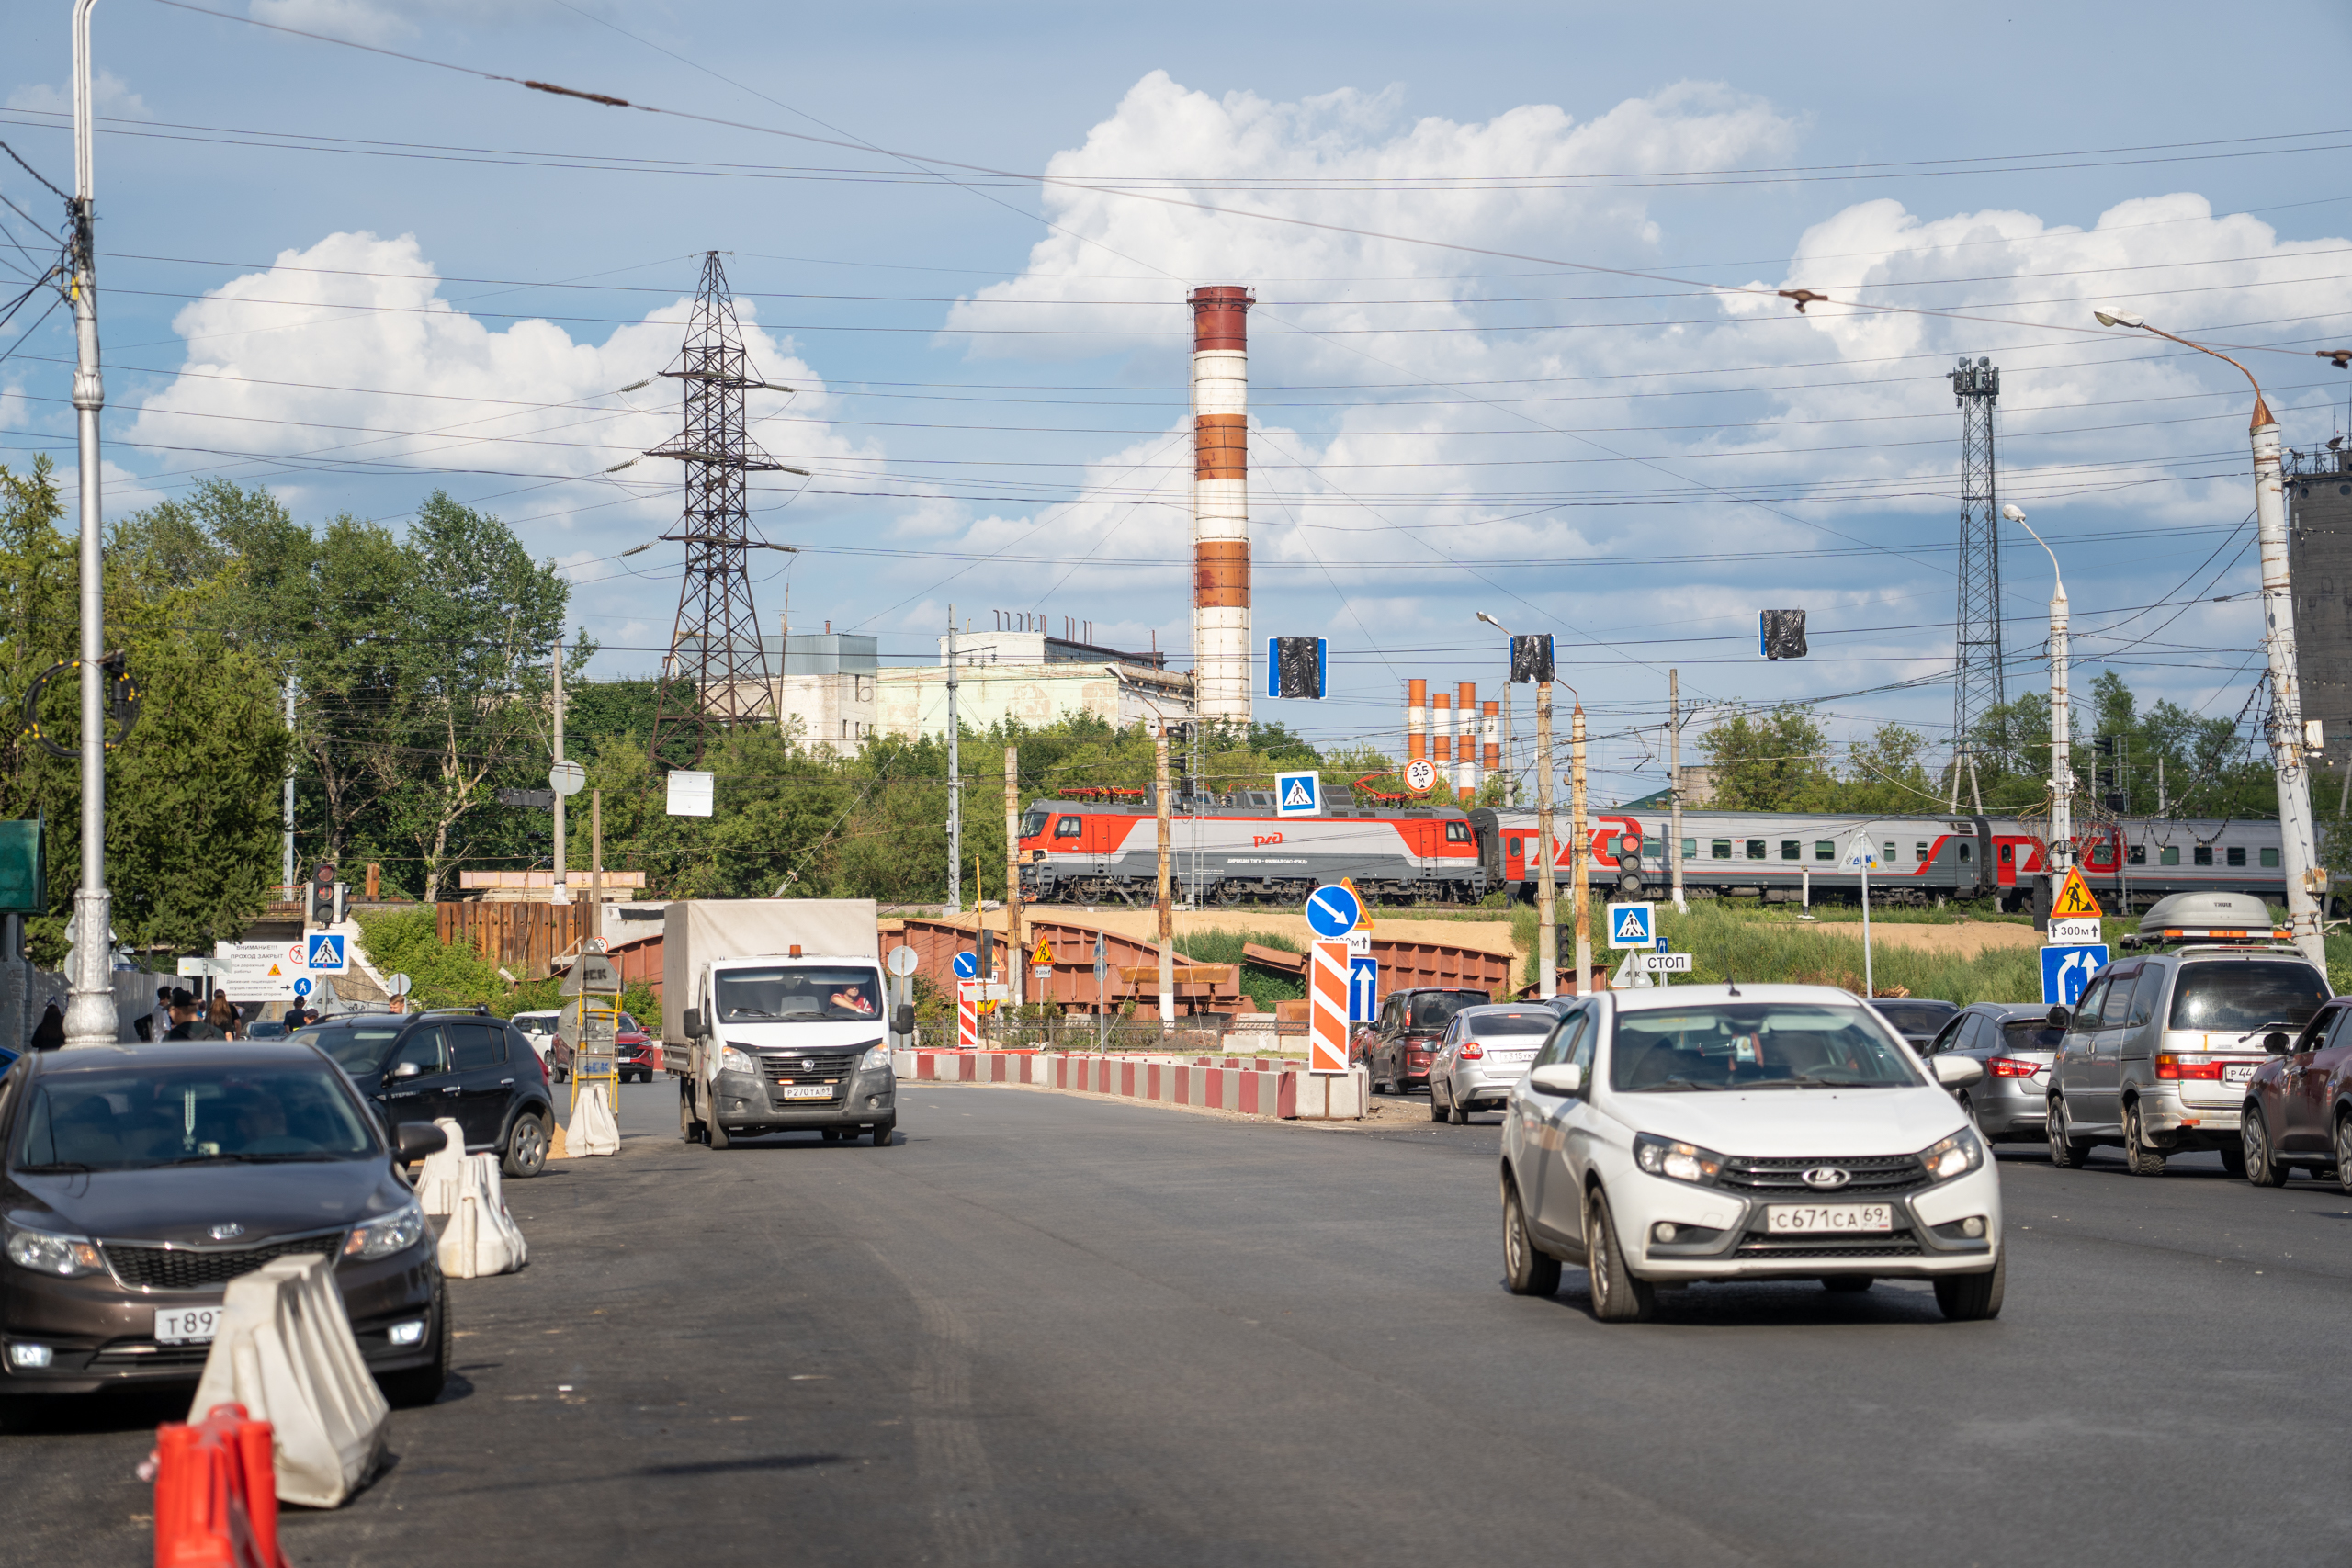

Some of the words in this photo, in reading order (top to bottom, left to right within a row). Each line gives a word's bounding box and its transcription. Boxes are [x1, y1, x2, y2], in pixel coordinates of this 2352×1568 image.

[1647, 957, 1684, 969] СТОП
[1777, 1209, 1858, 1228] С671СА
[1863, 1208, 1883, 1222] 69
[166, 1310, 222, 1336] Т89
